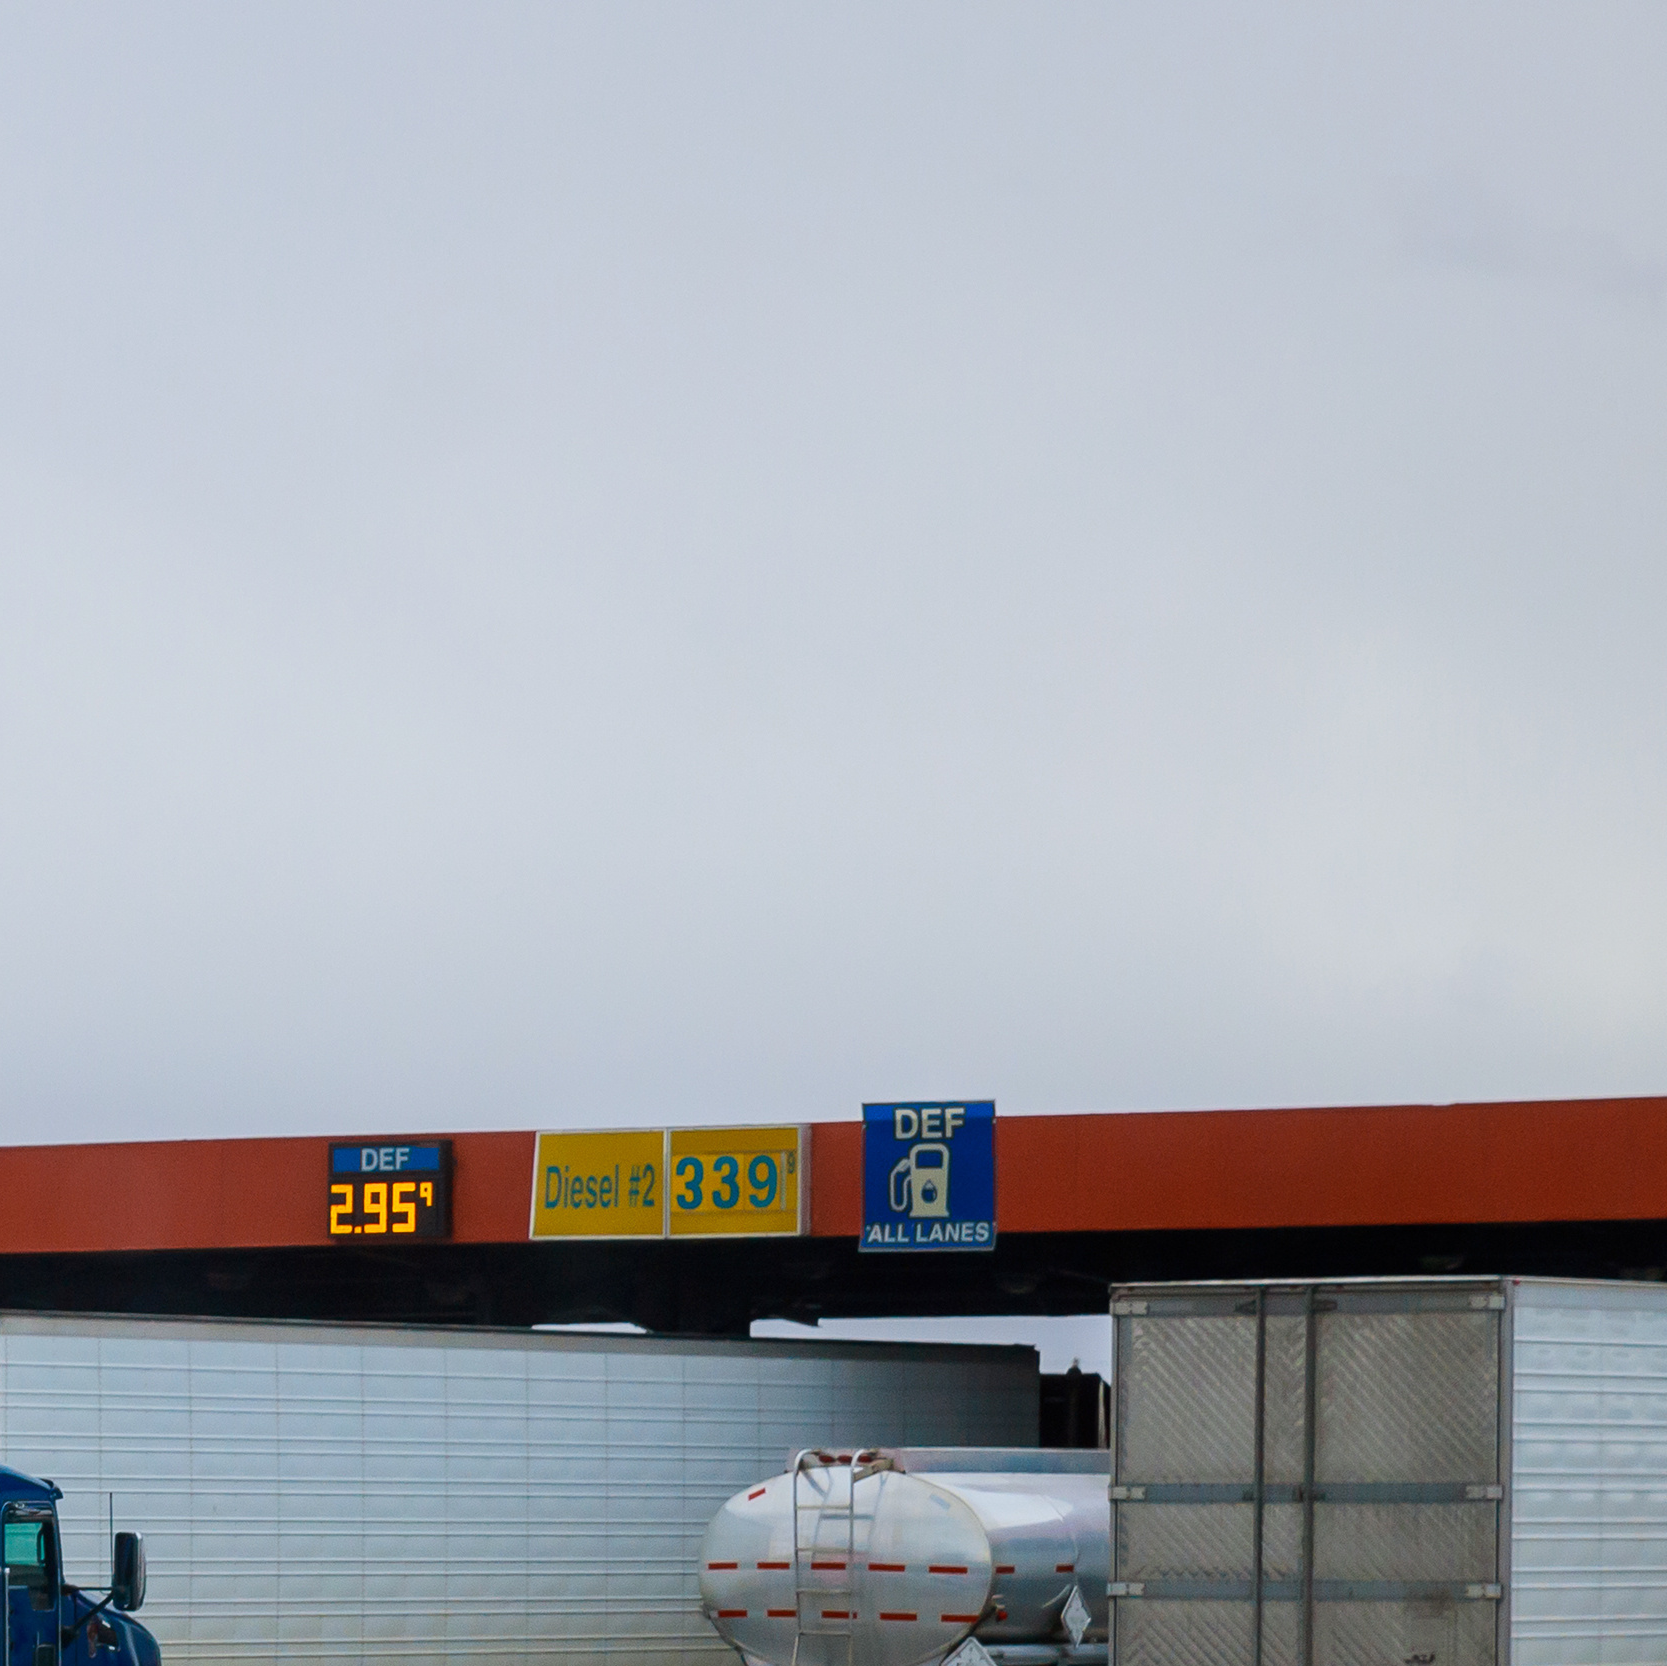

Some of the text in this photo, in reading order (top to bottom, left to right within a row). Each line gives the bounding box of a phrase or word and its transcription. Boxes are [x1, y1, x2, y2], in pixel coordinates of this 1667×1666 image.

[894, 1107, 966, 1139] DEF
[360, 1147, 411, 1172] DEF
[544, 1163, 656, 1209] Diesel #2
[867, 1221, 990, 1244] ALL LANES
